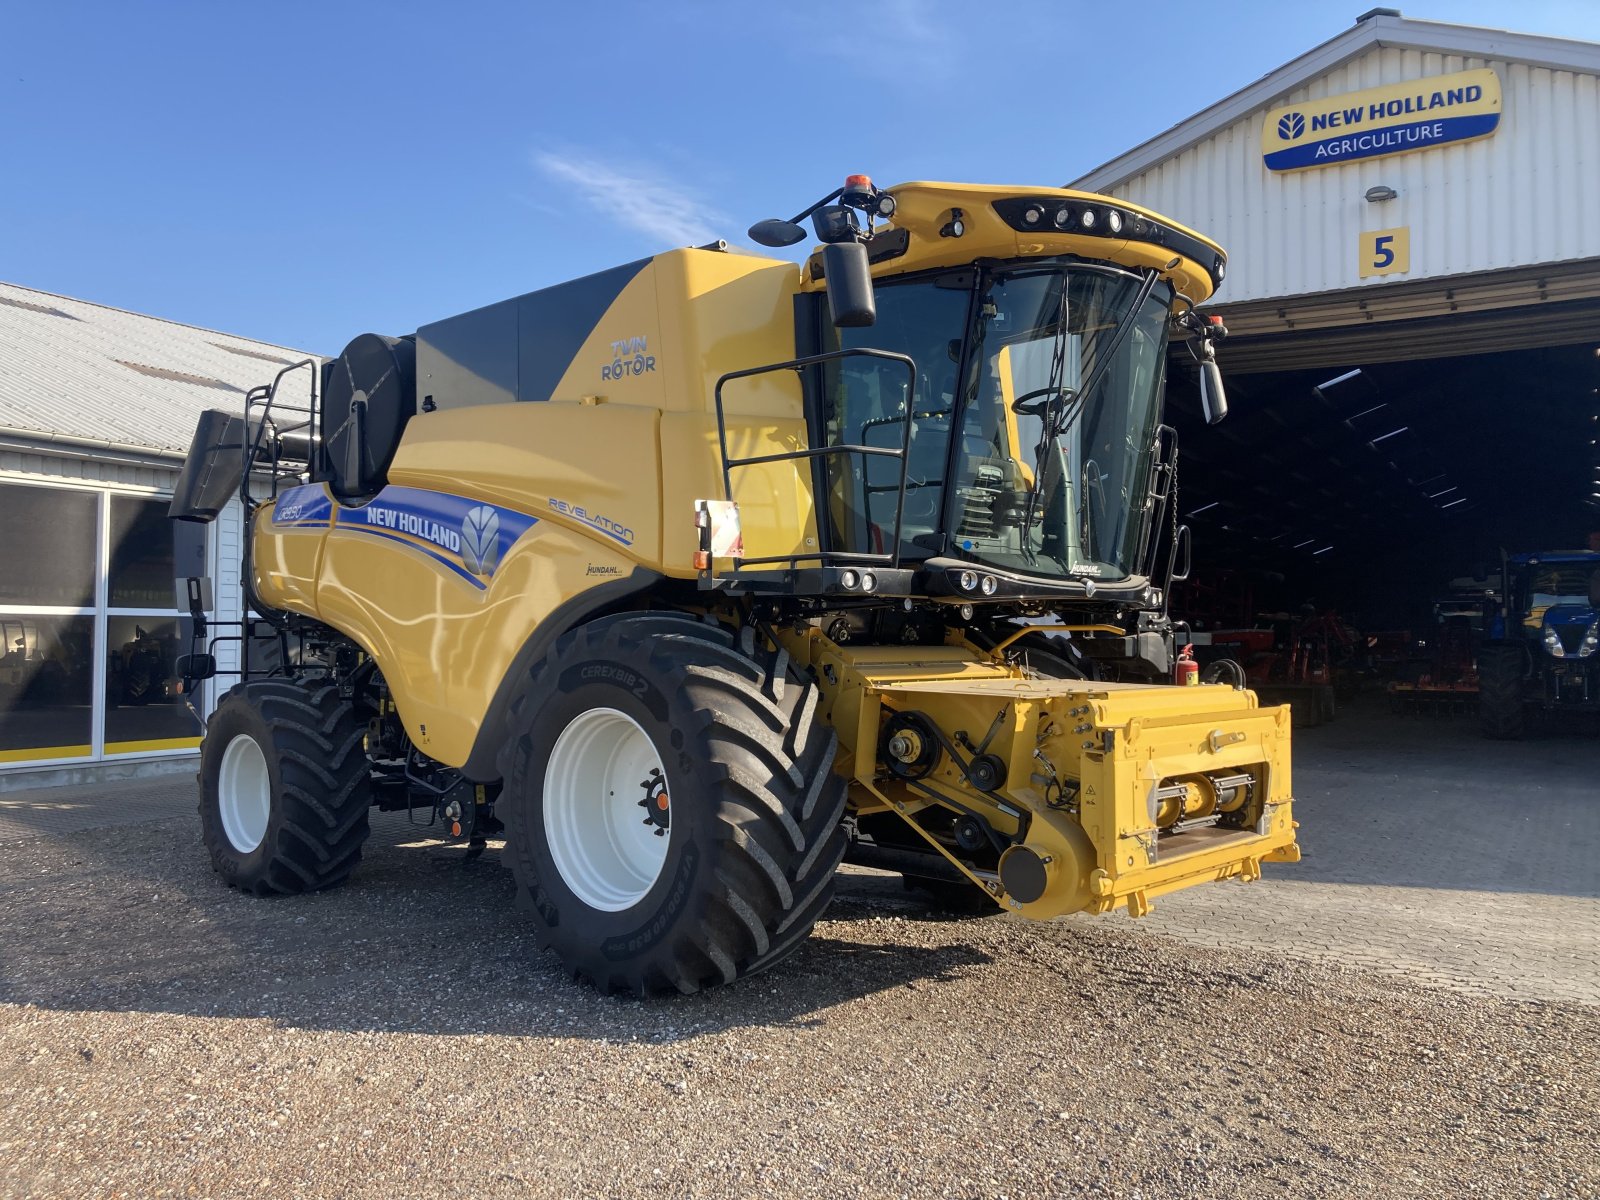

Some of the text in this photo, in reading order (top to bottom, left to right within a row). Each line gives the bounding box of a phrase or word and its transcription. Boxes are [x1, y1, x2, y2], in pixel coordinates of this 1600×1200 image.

[1312, 85, 1482, 131] NEW HOLLAND
[1315, 123, 1443, 158] AGRICULTURE
[1373, 236, 1395, 268] 5
[611, 335, 647, 357] TWIN
[602, 354, 656, 381] ROTOR
[367, 507, 460, 553] NEW HOLLAND
[548, 498, 634, 541] REVELATION
[580, 665, 648, 699] CEREXBIB 2
